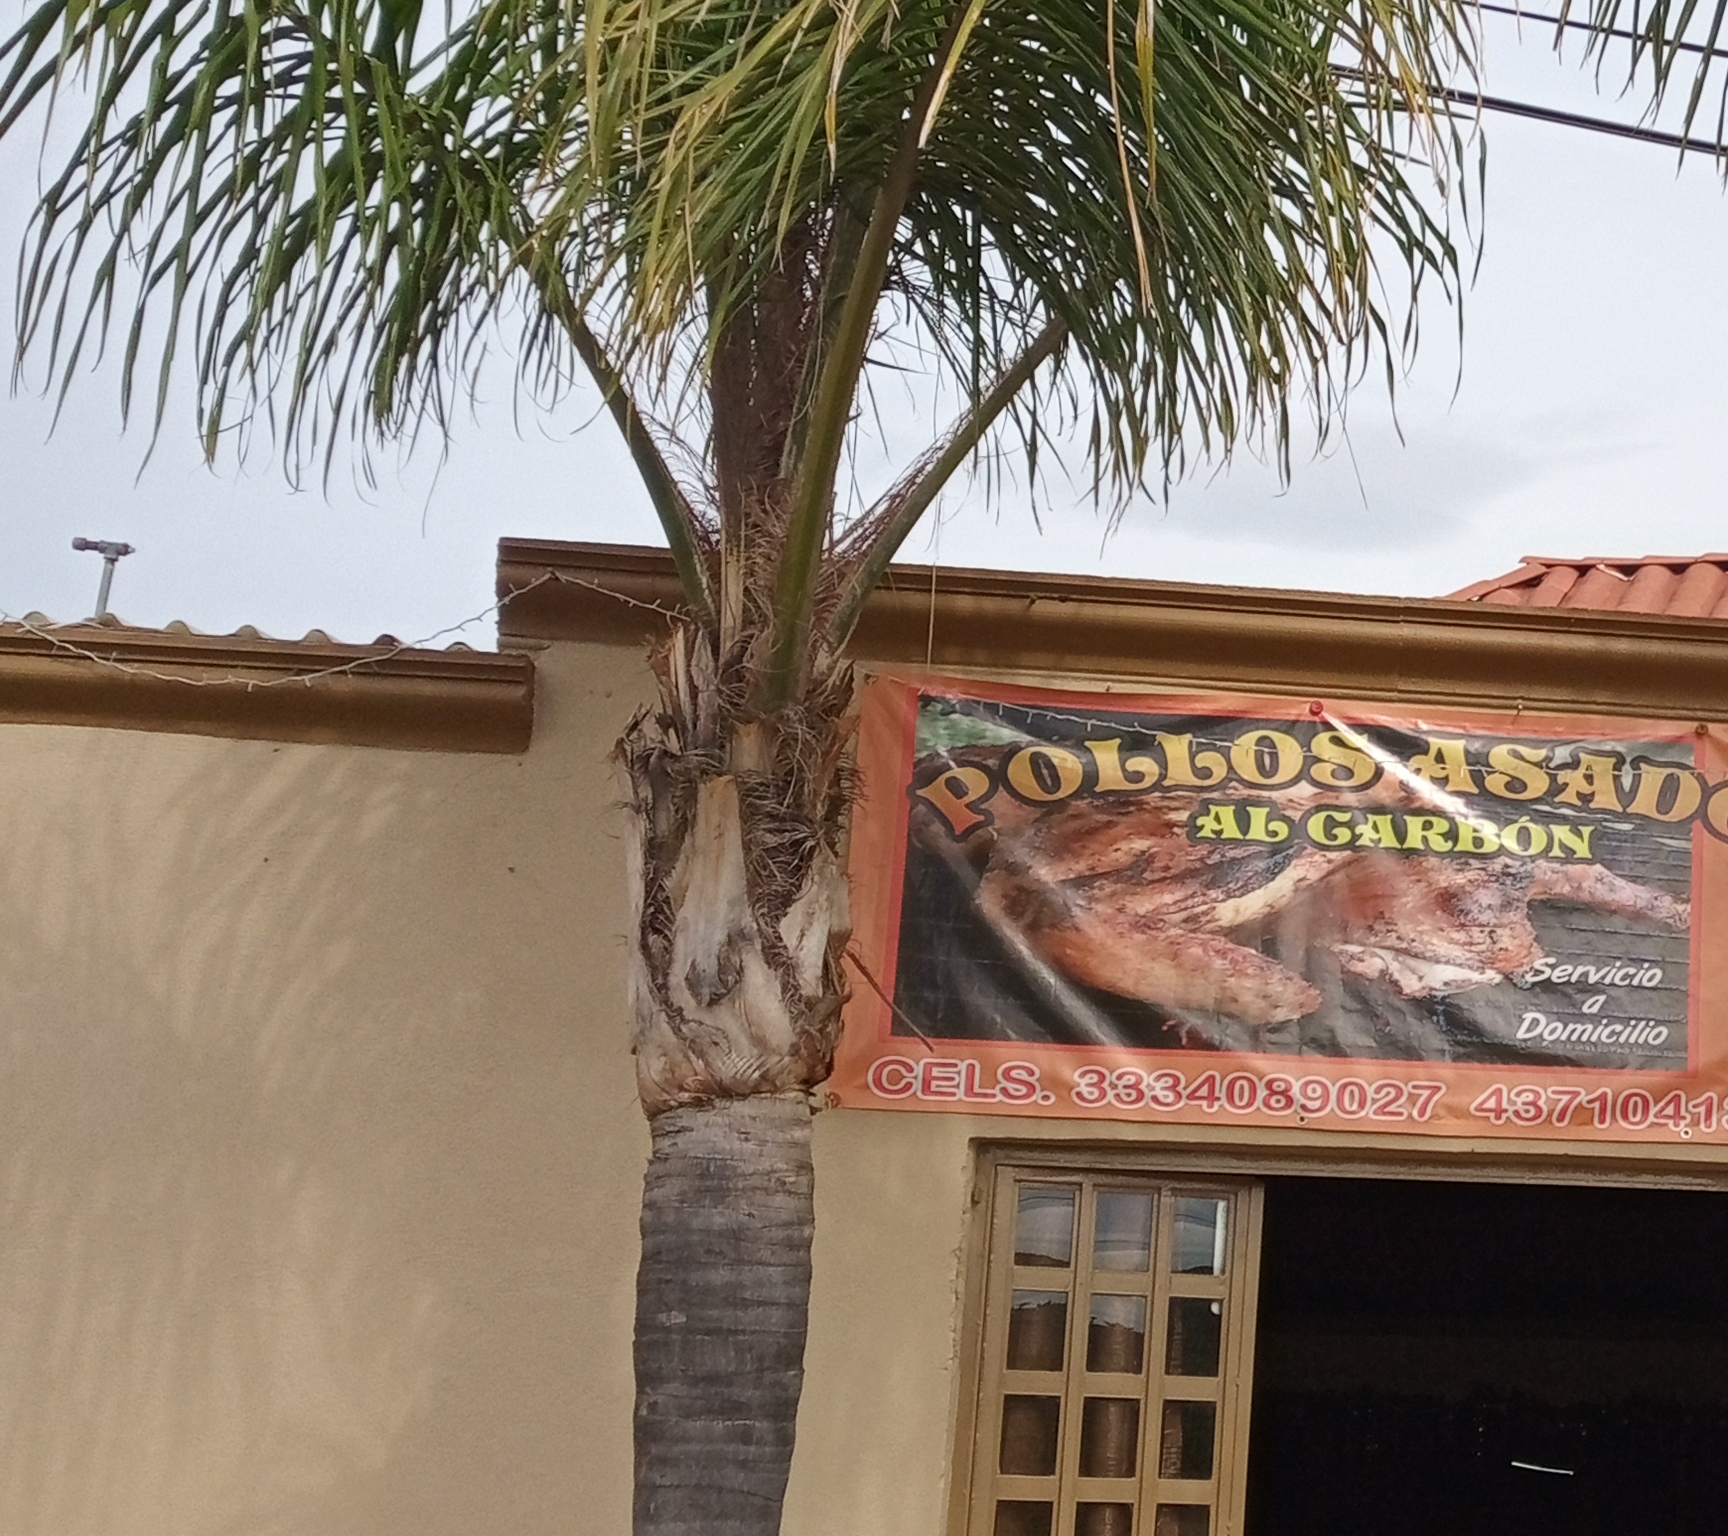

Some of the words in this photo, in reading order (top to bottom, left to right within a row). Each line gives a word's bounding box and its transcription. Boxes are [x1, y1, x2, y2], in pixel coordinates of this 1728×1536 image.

[914, 728, 1378, 836] POLLOS
[1195, 804, 1290, 843] AL
[1306, 811, 1597, 860] CARBÓN
[1523, 956, 1663, 988] Servicio
[1581, 992, 1608, 1015] a
[1514, 1011, 1671, 1048] Domicilio
[867, 1055, 1057, 1106] CELS.
[1071, 1066, 1445, 1122] 3334089027
